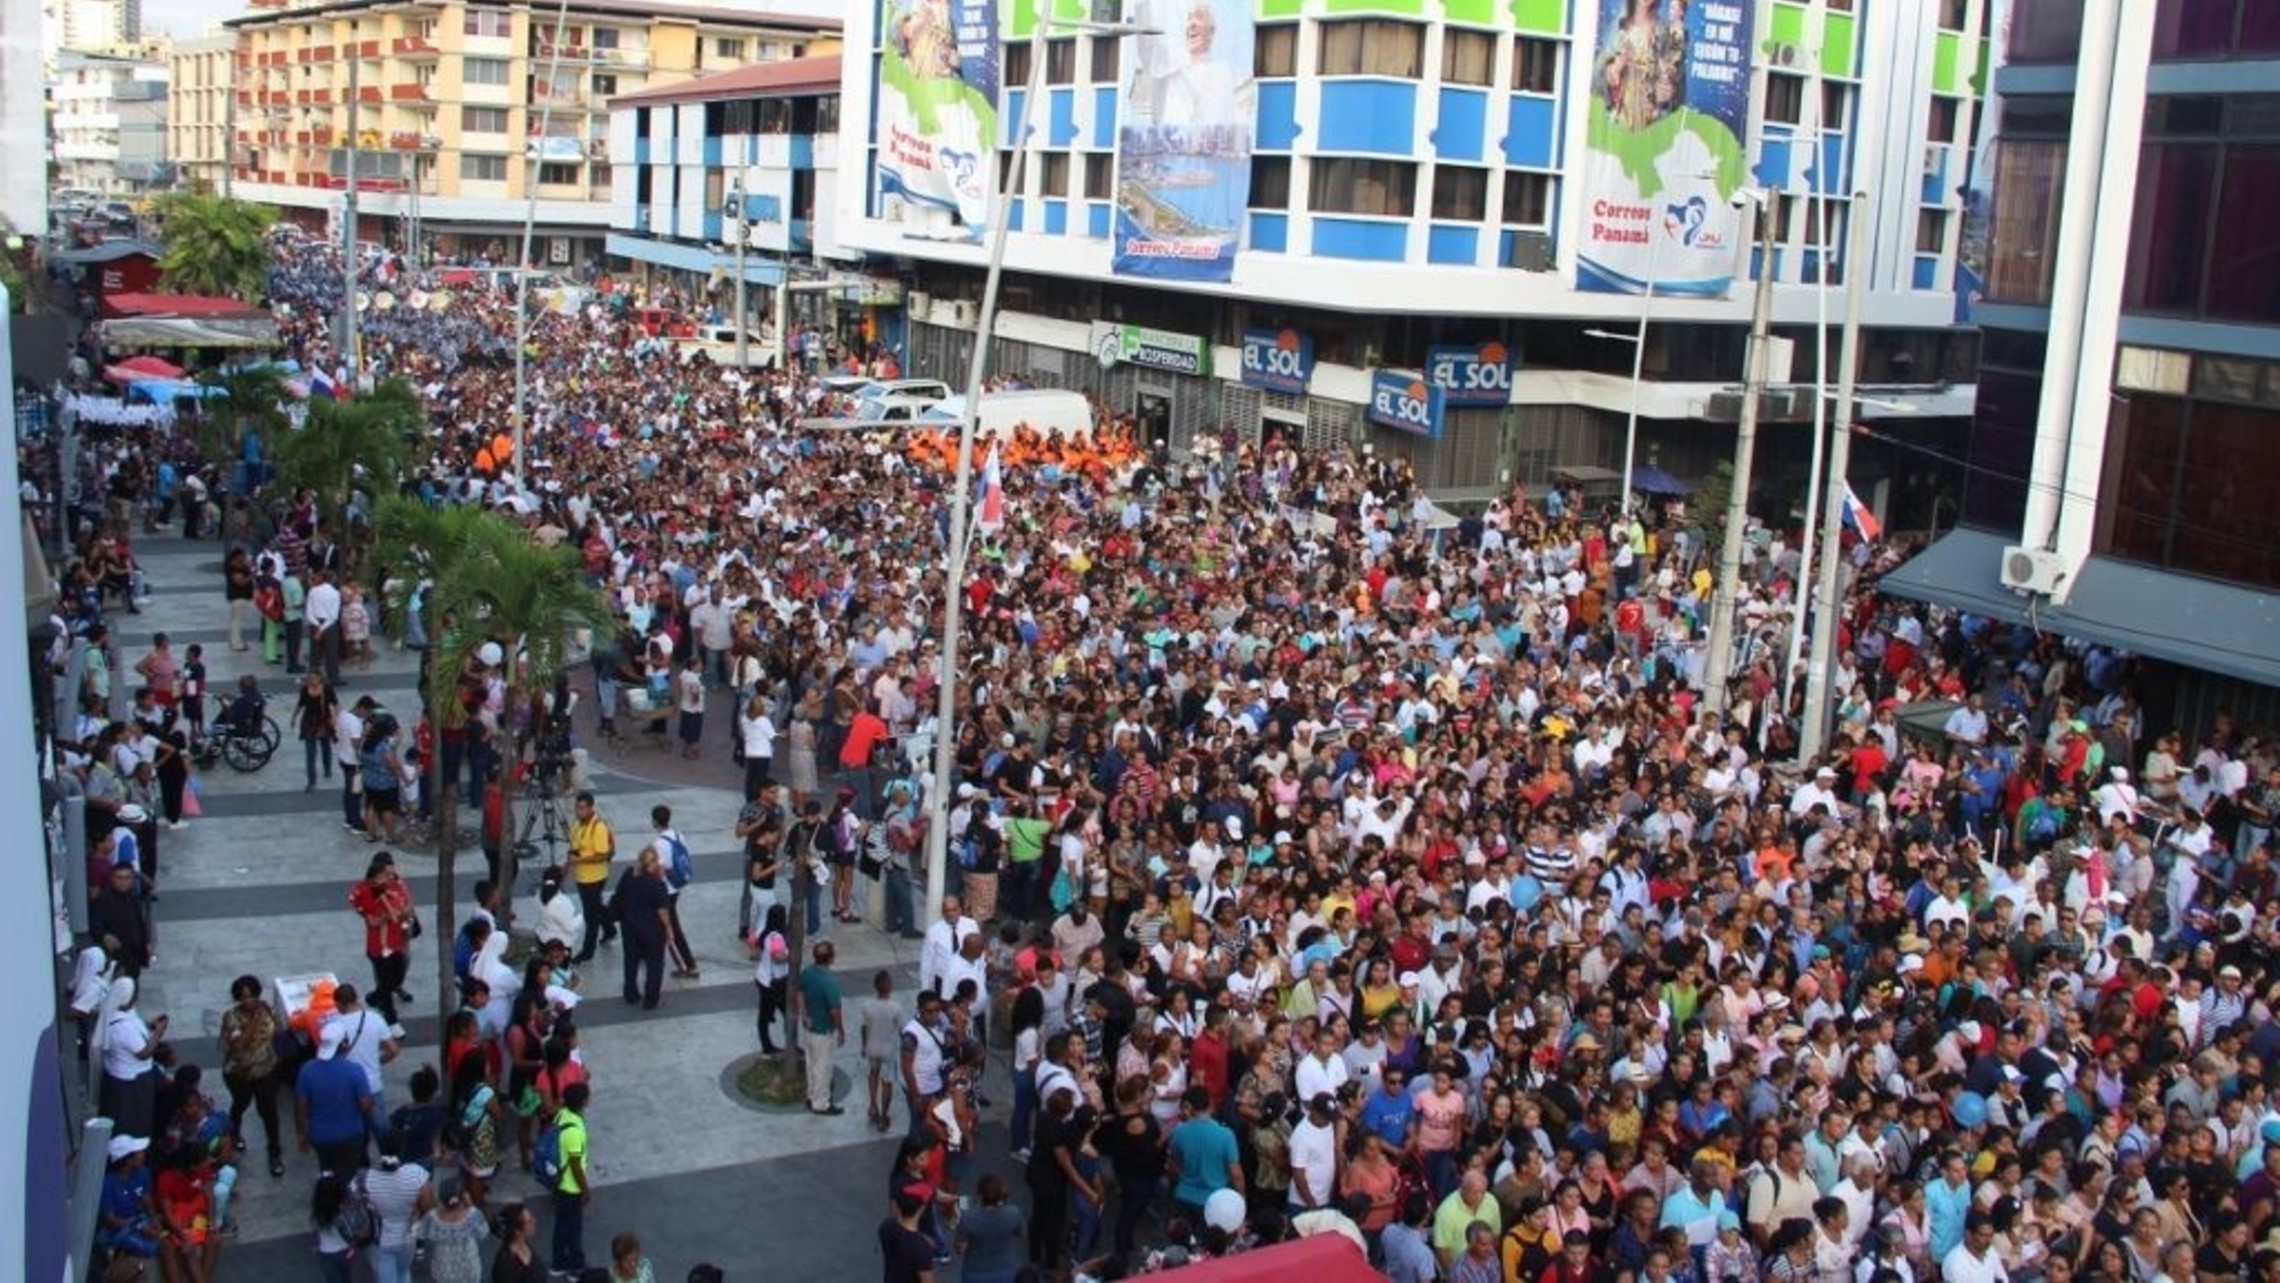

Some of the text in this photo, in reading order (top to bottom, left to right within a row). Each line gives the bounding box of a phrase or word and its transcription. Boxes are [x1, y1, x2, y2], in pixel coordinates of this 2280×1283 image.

[1594, 200, 1651, 221] Correos
[1592, 223, 1649, 244] Panamá
[1244, 344, 1304, 378] EL SOL
[1433, 362, 1459, 389] EL
[1465, 362, 1511, 389] SOL
[1376, 392, 1392, 416] EL
[1398, 397, 1431, 426] SOL
